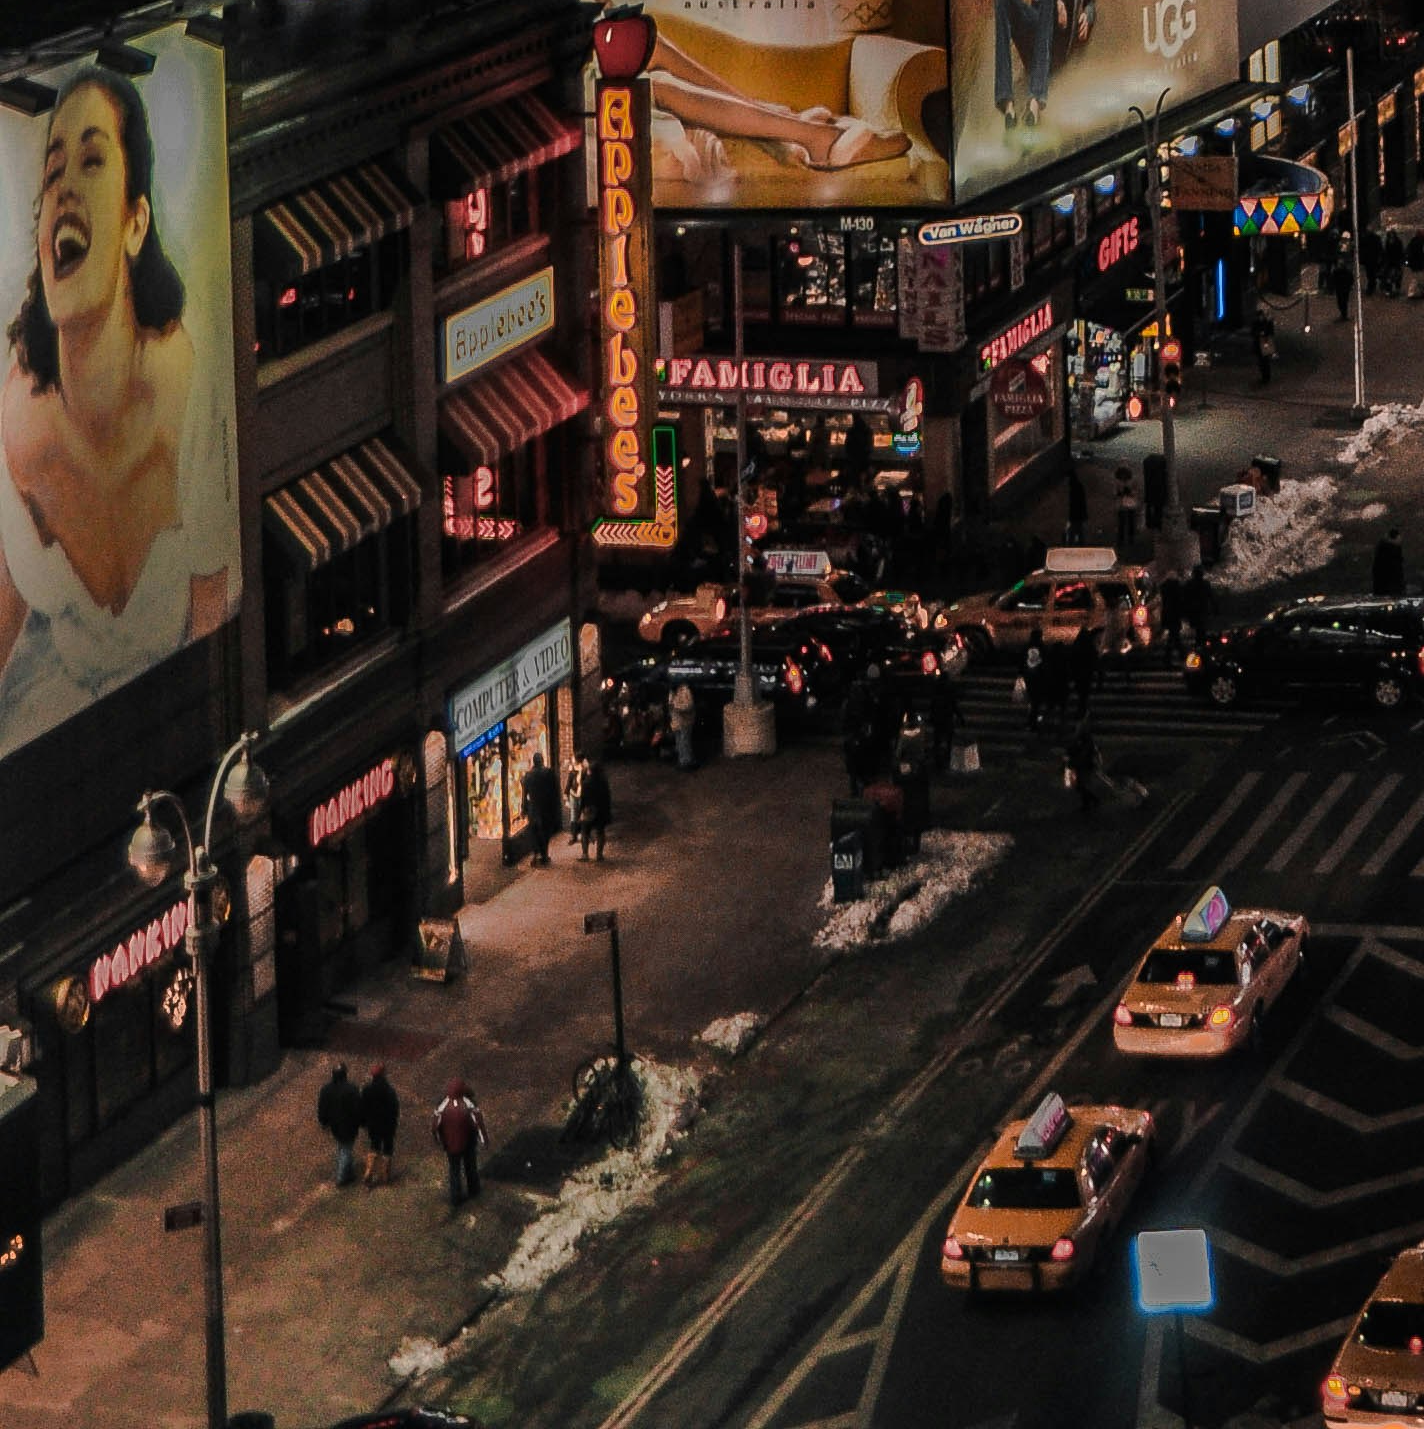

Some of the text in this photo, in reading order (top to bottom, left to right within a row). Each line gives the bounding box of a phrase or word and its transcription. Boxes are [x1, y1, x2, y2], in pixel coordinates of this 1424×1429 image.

[840, 214, 875, 232] M-130
[927, 215, 1018, 241] Van Wagner
[1096, 214, 1141, 273] GIFTS
[453, 288, 551, 363] Applebee's
[599, 84, 647, 518] Applebee's
[669, 357, 866, 393] FAMIGLIA
[1004, 403, 1035, 416] PIZZA
[455, 665, 521, 735] COMPUTER
[533, 635, 571, 679] VIDEO
[308, 757, 396, 847] NANKING
[89, 898, 192, 1003] NANKIN
